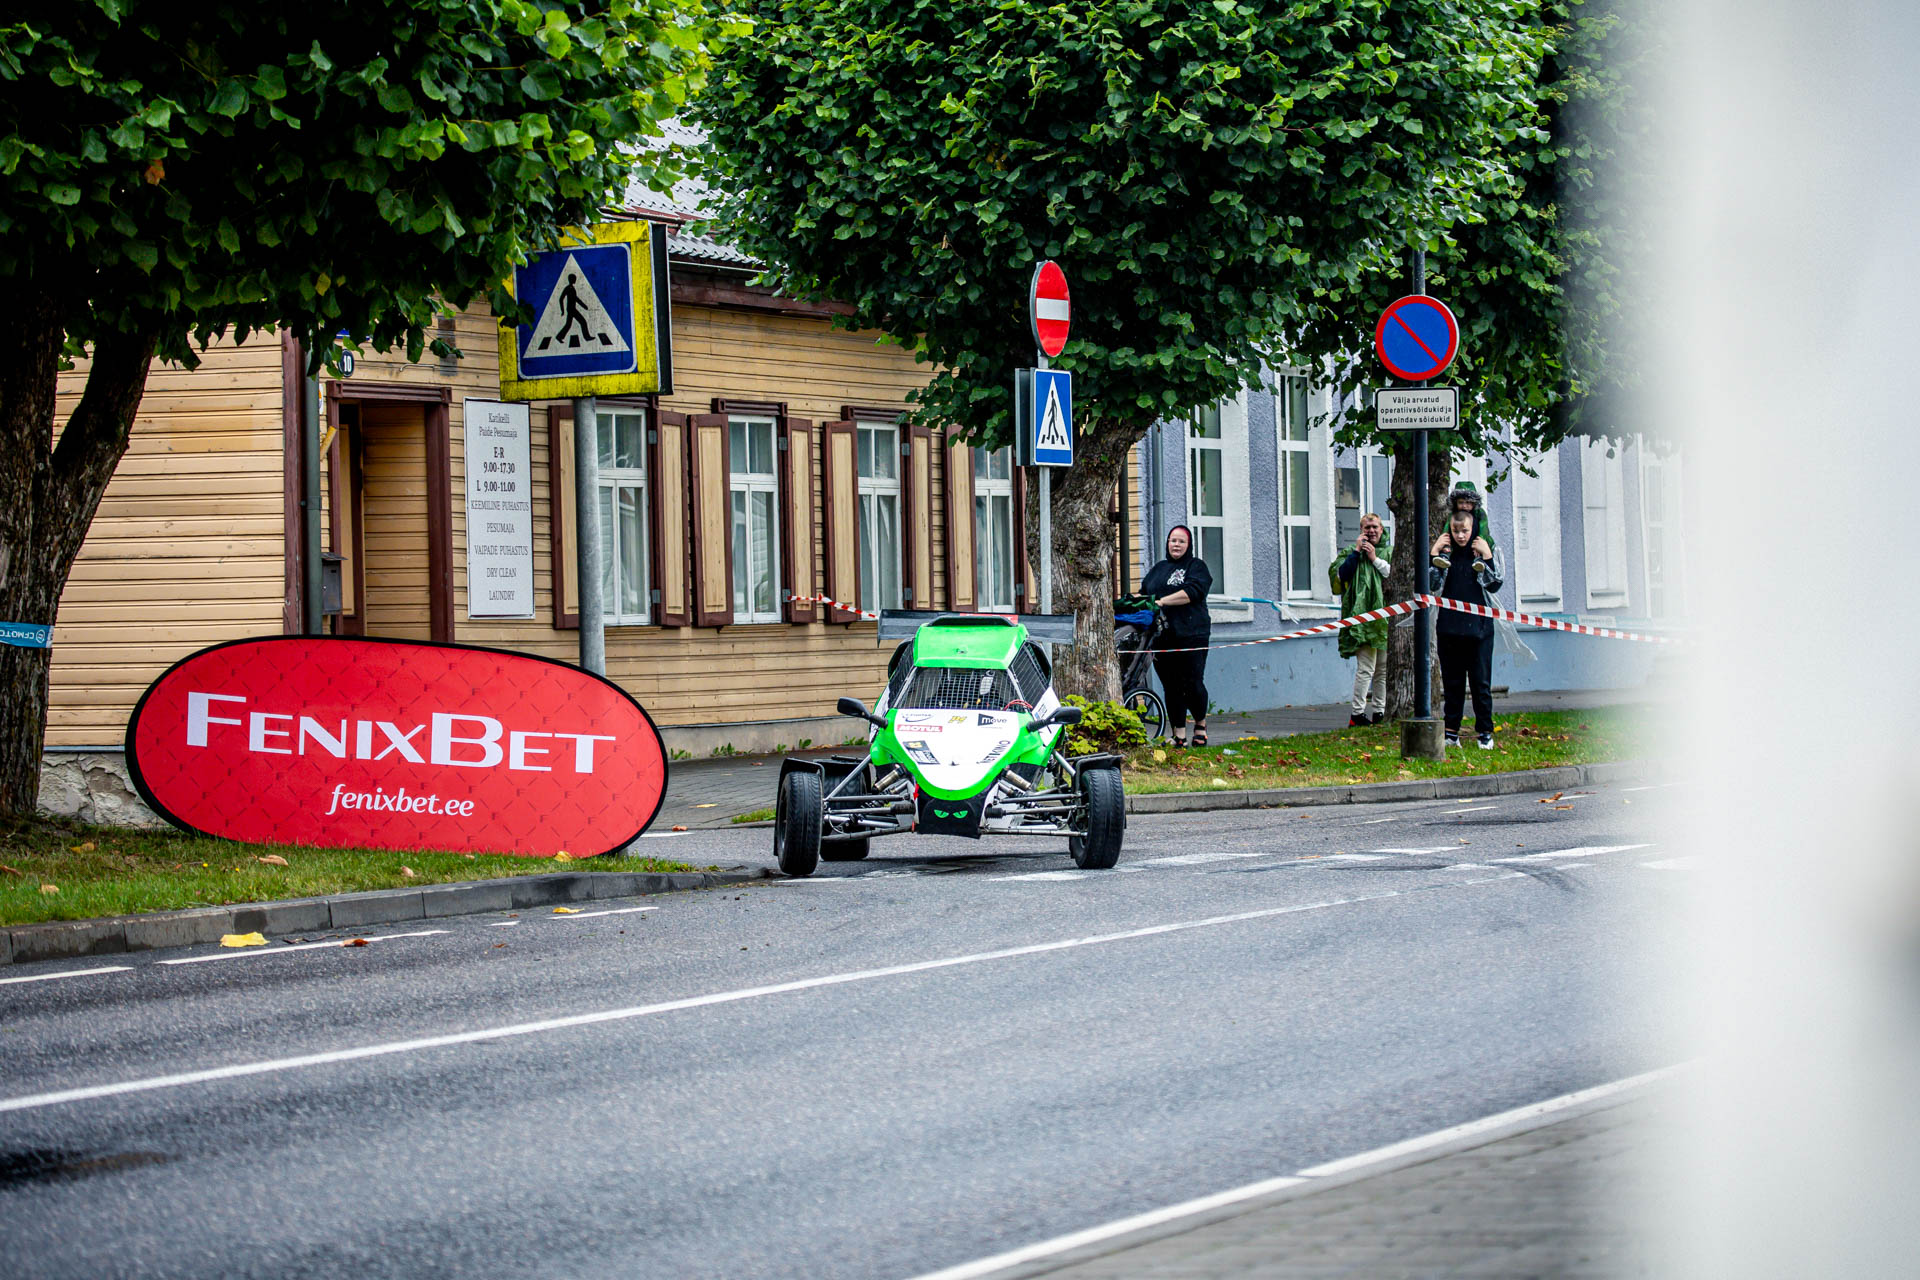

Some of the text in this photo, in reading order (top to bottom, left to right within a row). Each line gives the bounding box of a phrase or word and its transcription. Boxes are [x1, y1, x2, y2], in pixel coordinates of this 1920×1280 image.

[343, 355, 352, 373] 10
[1392, 396, 1440, 405] Välja arvatud
[494, 427, 518, 439] Pesumaja
[493, 446, 505, 458] E-R
[483, 461, 516, 474] 9.00-17.30
[476, 479, 516, 492] L 9.00-11.00
[471, 500, 530, 512] KEEMILINE PUHASTUS
[486, 522, 515, 534] PESUMAJA
[474, 544, 529, 556] VAIPADE PUHASTUS
[486, 567, 517, 578] DRY CLEAN
[488, 590, 515, 601] LAUNDRY
[325, 783, 475, 817] fenixbet.ee
